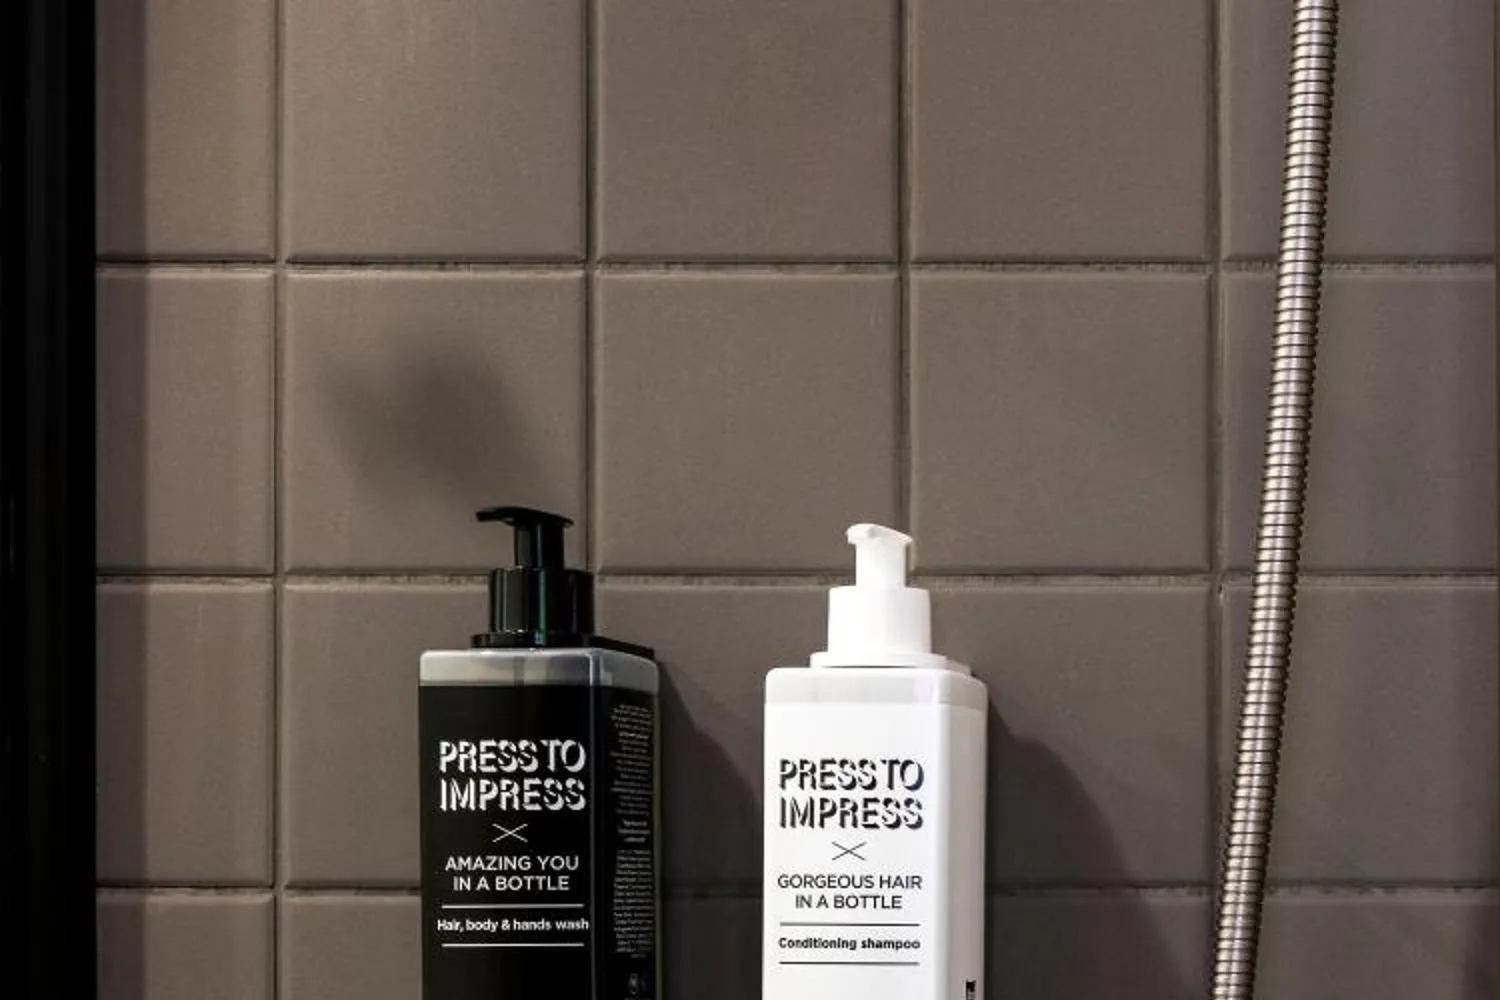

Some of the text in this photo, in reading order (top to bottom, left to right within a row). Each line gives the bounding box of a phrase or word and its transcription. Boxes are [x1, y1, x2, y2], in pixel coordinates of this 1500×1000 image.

[439, 739, 586, 773] PRESS TO
[779, 758, 924, 792] PRESS TO
[440, 777, 586, 811] IMPRESS
[779, 796, 923, 829] IMPRESS
[445, 855, 579, 871] AMAZING YOU
[453, 875, 570, 891] IN A BOTTLE
[777, 873, 922, 889] GORGEOUS HAIR
[795, 894, 903, 909] IN A BOTTLE
[437, 918, 589, 932] Hair, body & hands wash
[778, 937, 921, 951] Conditioning shampoo
